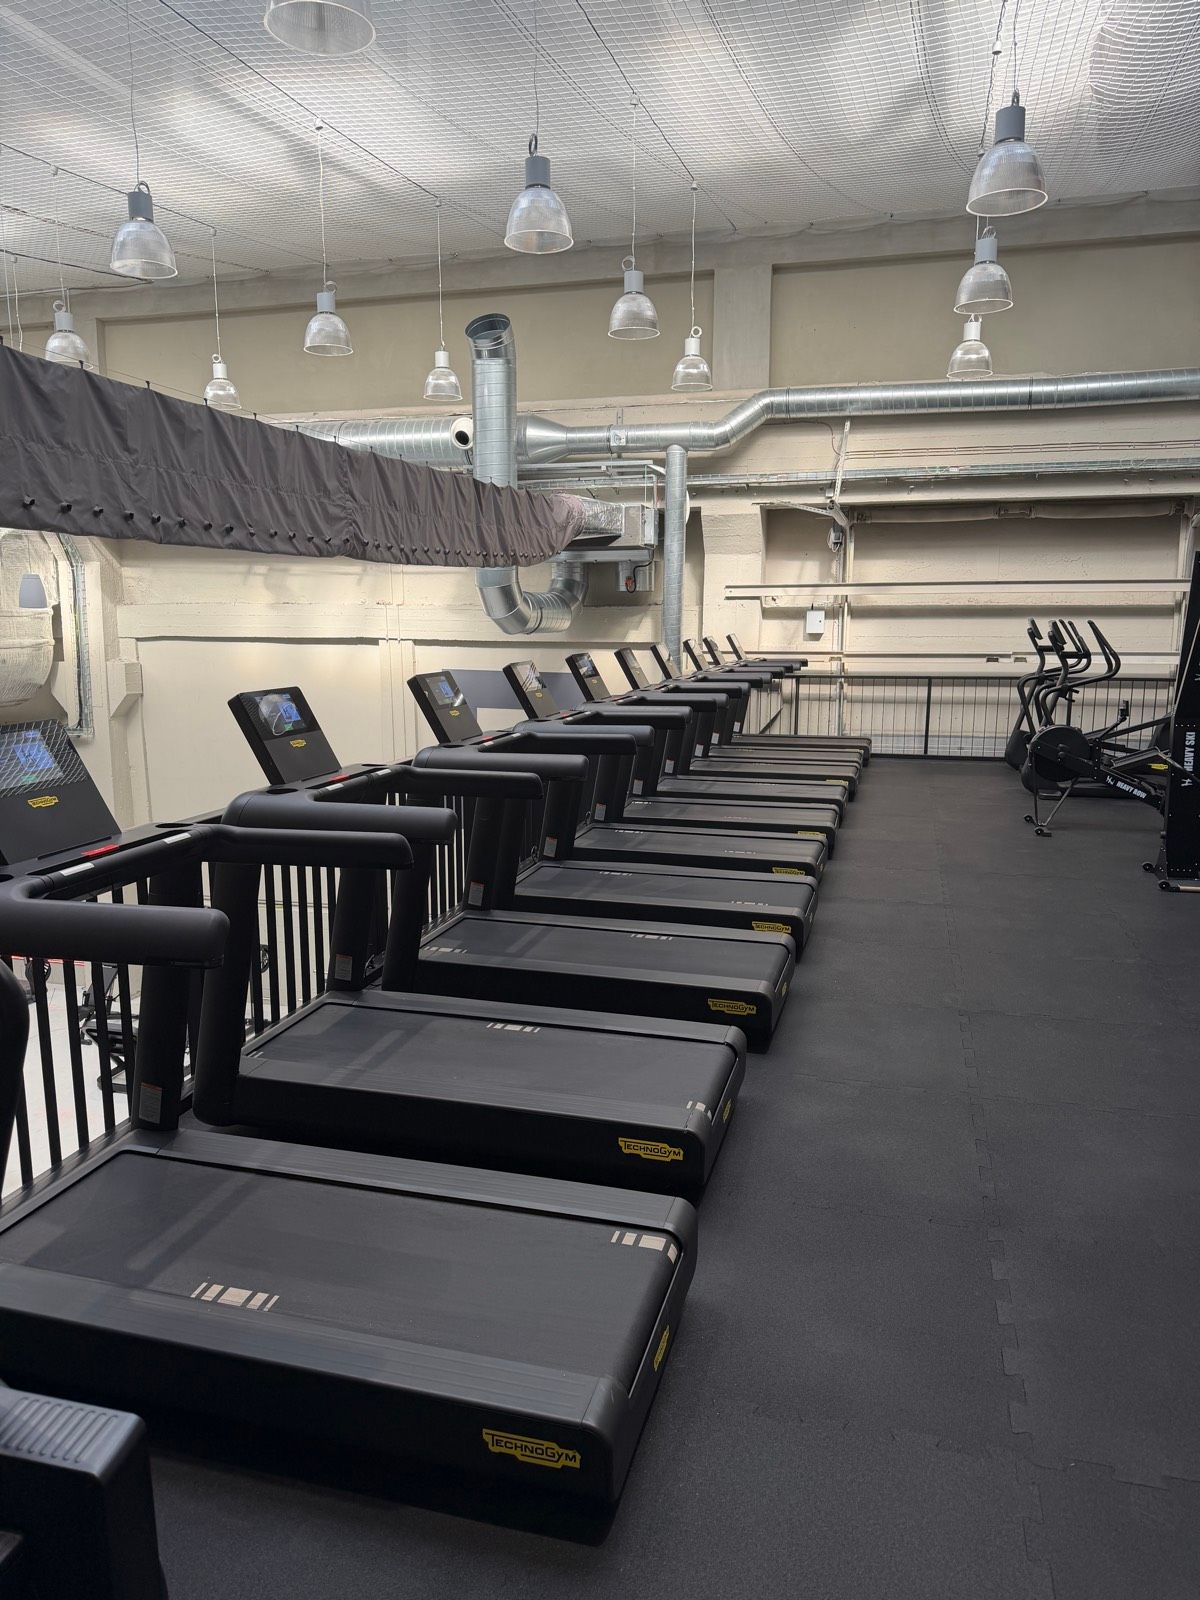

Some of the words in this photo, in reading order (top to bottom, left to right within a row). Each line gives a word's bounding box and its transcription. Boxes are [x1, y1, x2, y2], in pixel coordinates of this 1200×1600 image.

[1185, 732, 1195, 746] SKI
[1184, 747, 1194, 772] HEAVY
[1116, 781, 1134, 793] HEAVY
[1132, 788, 1147, 799] ROW
[620, 1140, 681, 1158] TECHNOGYM
[484, 1432, 577, 1463] TECHNOGYM
